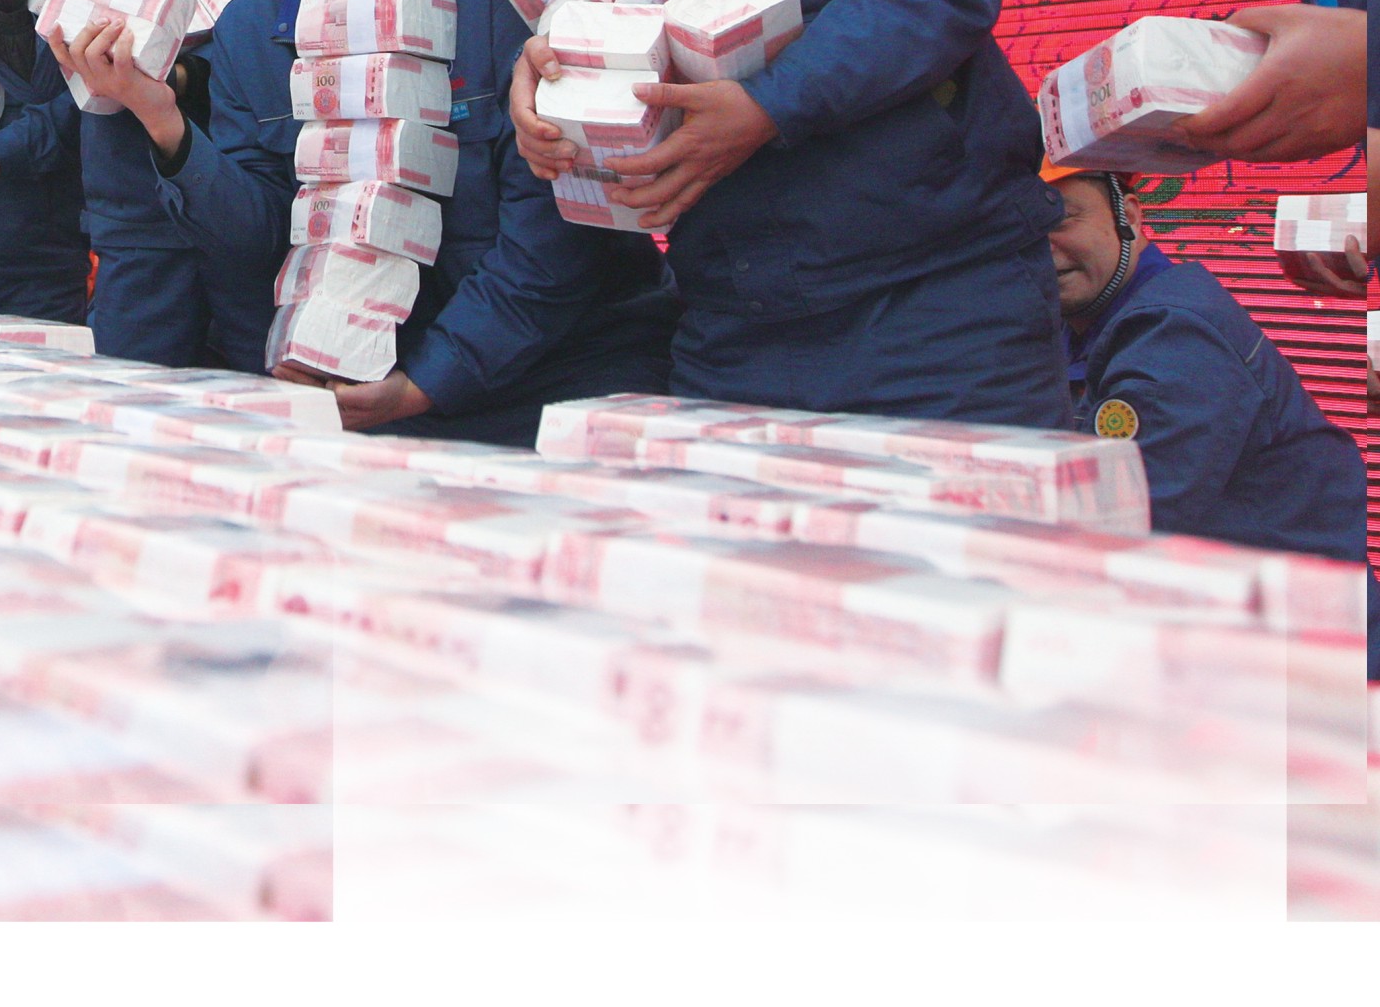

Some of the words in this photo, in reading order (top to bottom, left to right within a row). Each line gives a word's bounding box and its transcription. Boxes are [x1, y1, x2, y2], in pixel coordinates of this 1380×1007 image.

[315, 75, 336, 88] 100
[1090, 82, 1112, 108] 100
[312, 200, 330, 212] 100
